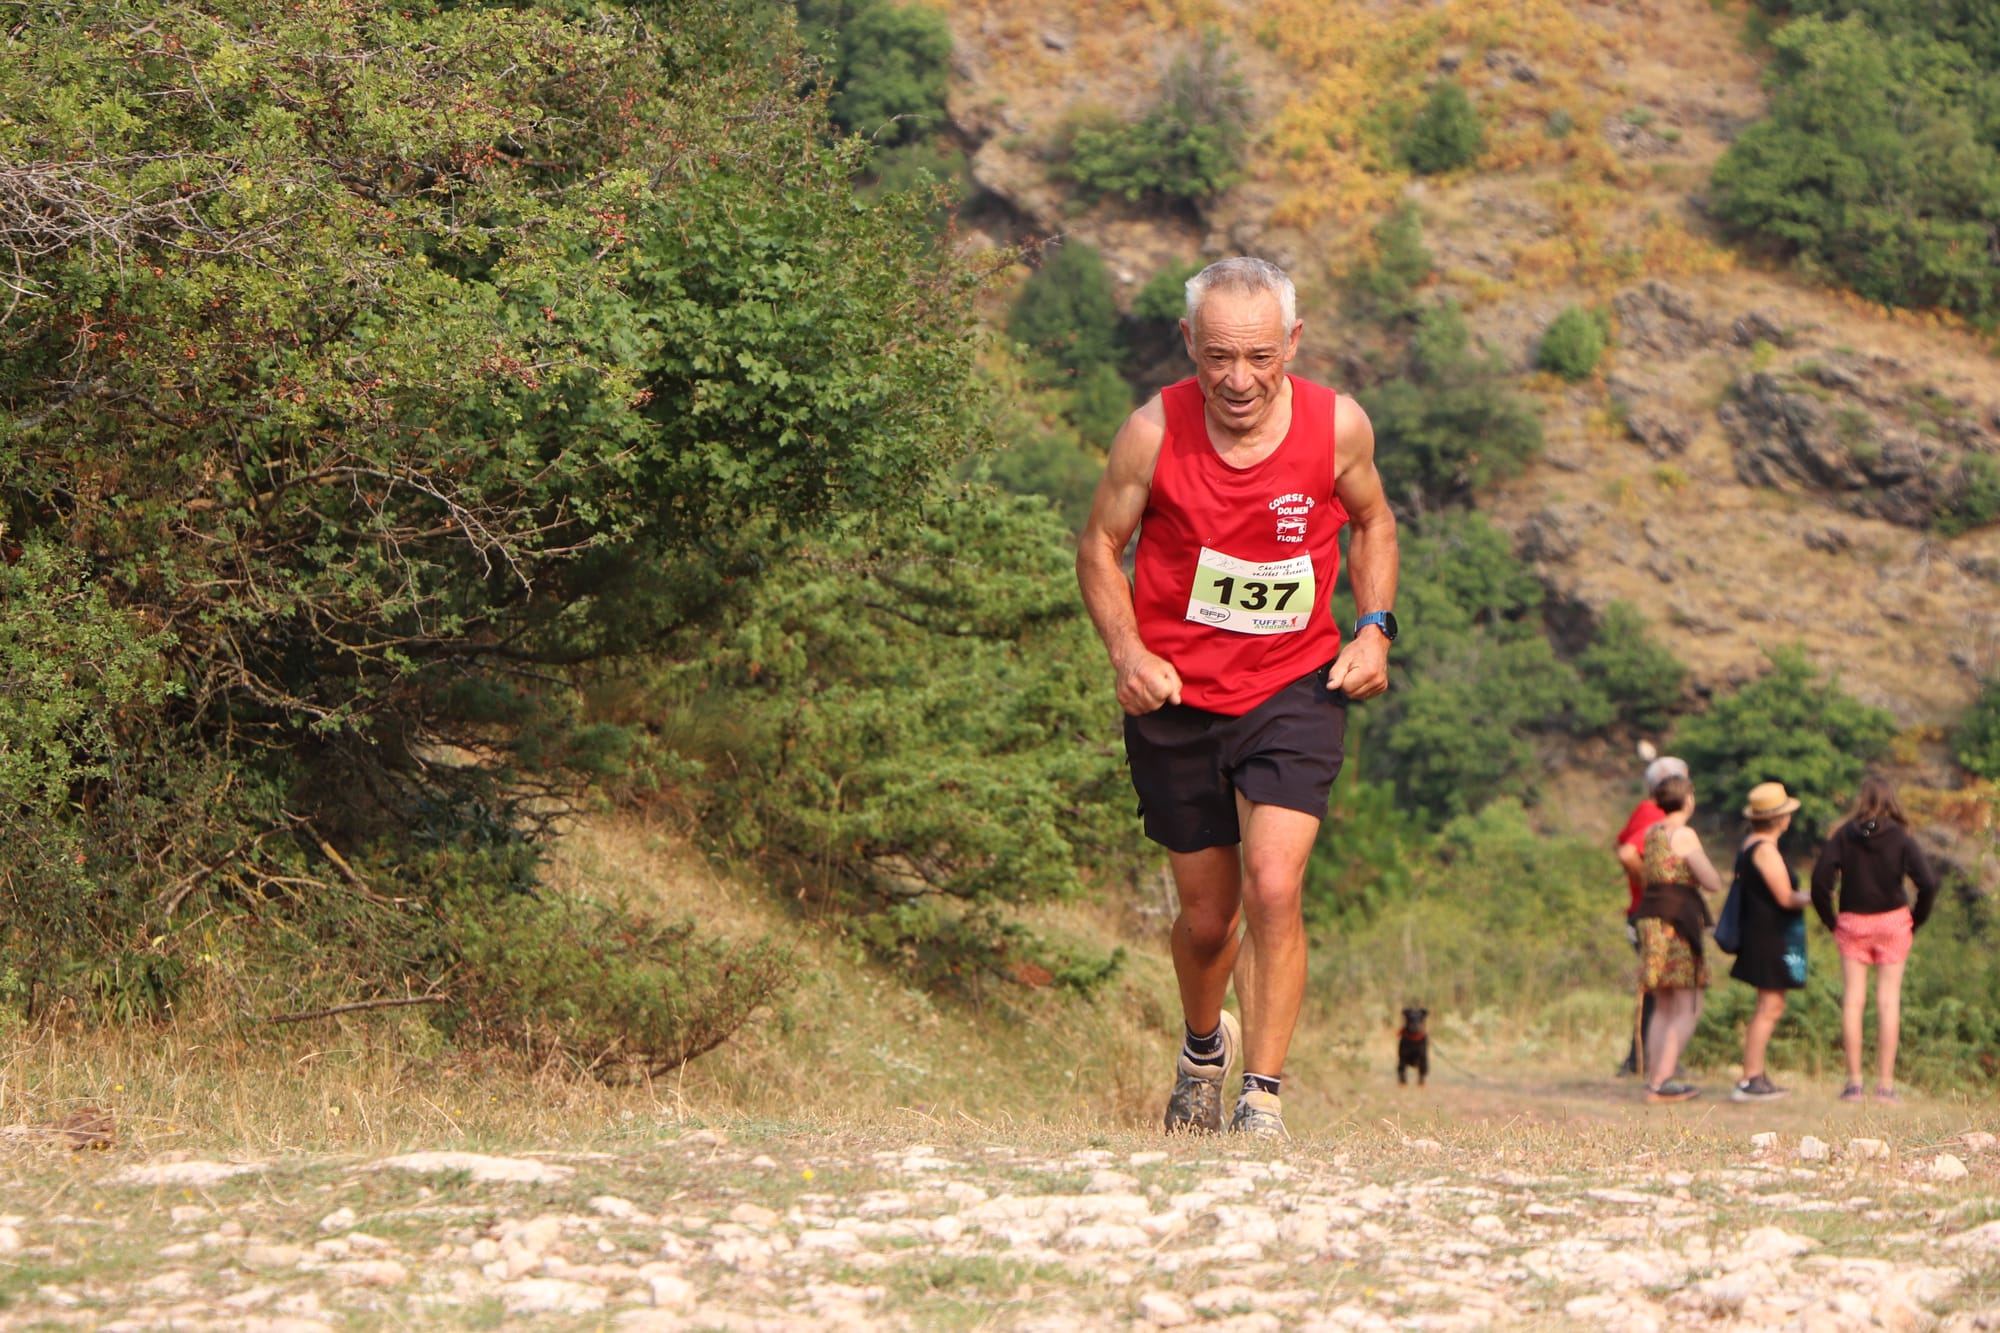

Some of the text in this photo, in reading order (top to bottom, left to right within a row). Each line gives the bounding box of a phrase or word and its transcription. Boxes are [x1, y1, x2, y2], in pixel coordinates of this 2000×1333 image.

[1269, 493, 1304, 510] COURSE
[1277, 506, 1309, 515] DOLMEN
[1213, 576, 1300, 611] 137
